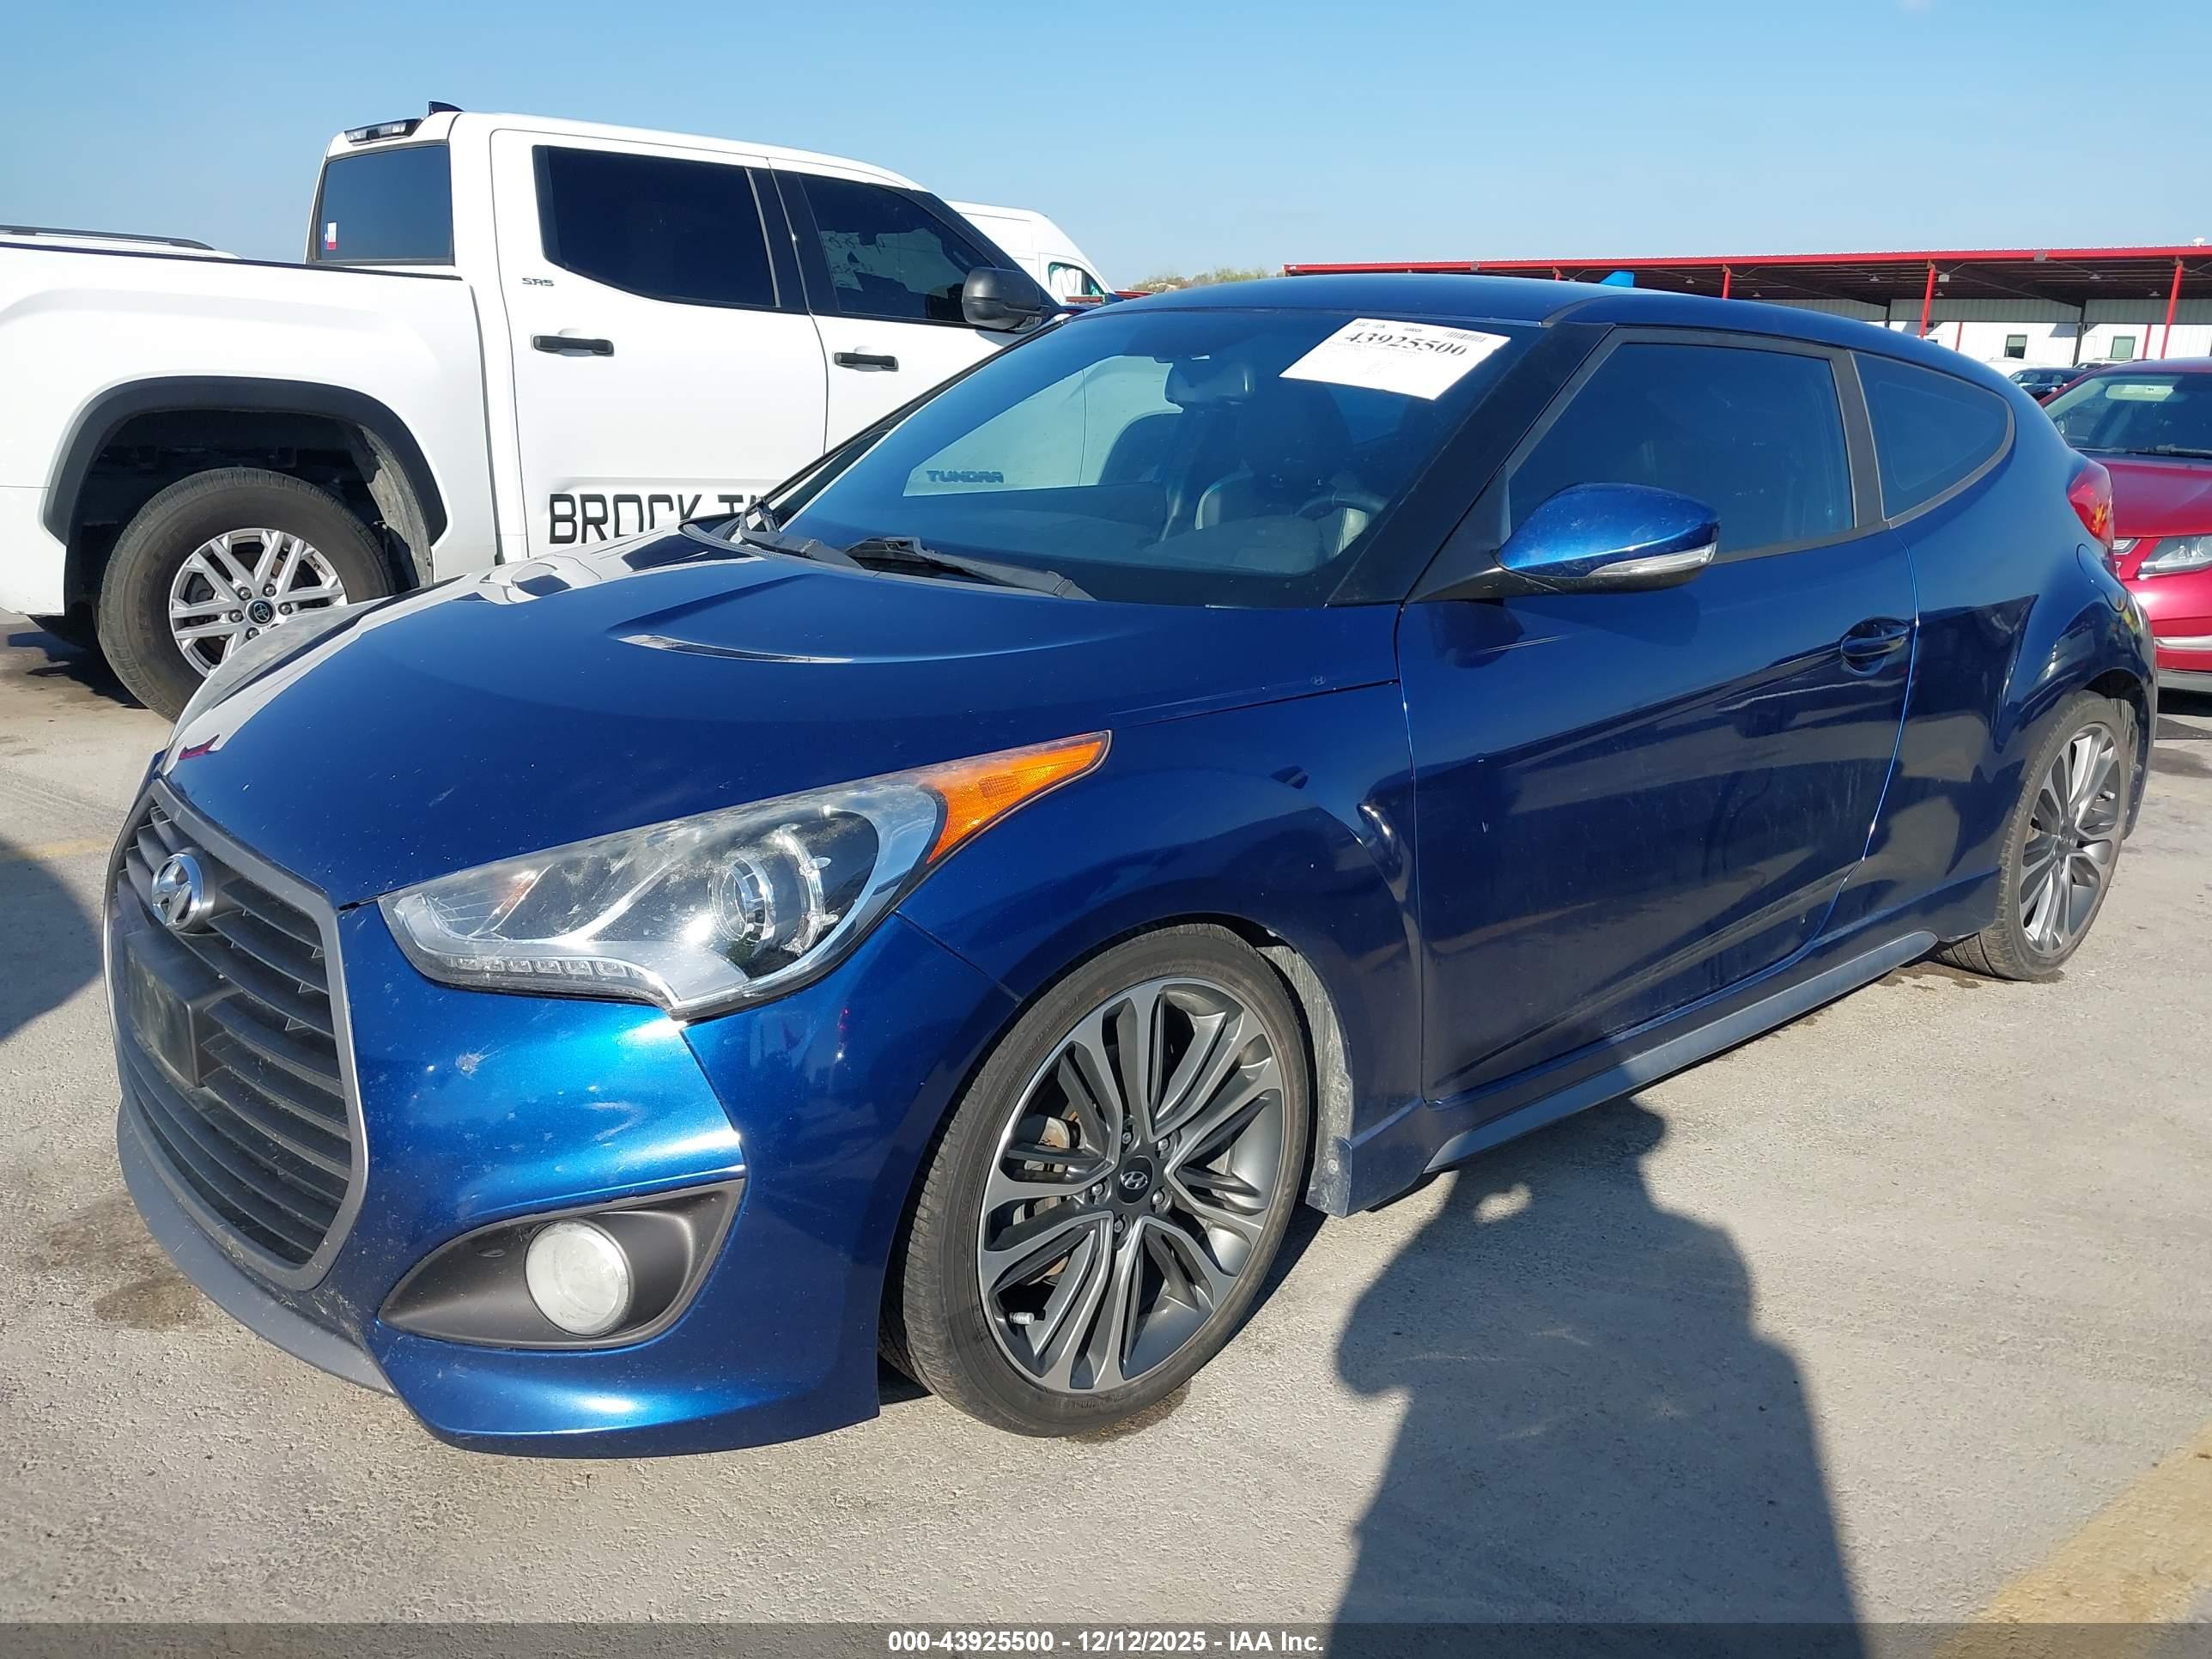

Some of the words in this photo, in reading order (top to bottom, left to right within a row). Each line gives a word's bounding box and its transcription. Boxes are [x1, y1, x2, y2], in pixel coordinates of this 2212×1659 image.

[1345, 331, 1468, 356] 43925500
[927, 470, 1005, 483] TUNDRA
[550, 494, 702, 544] BROCK
